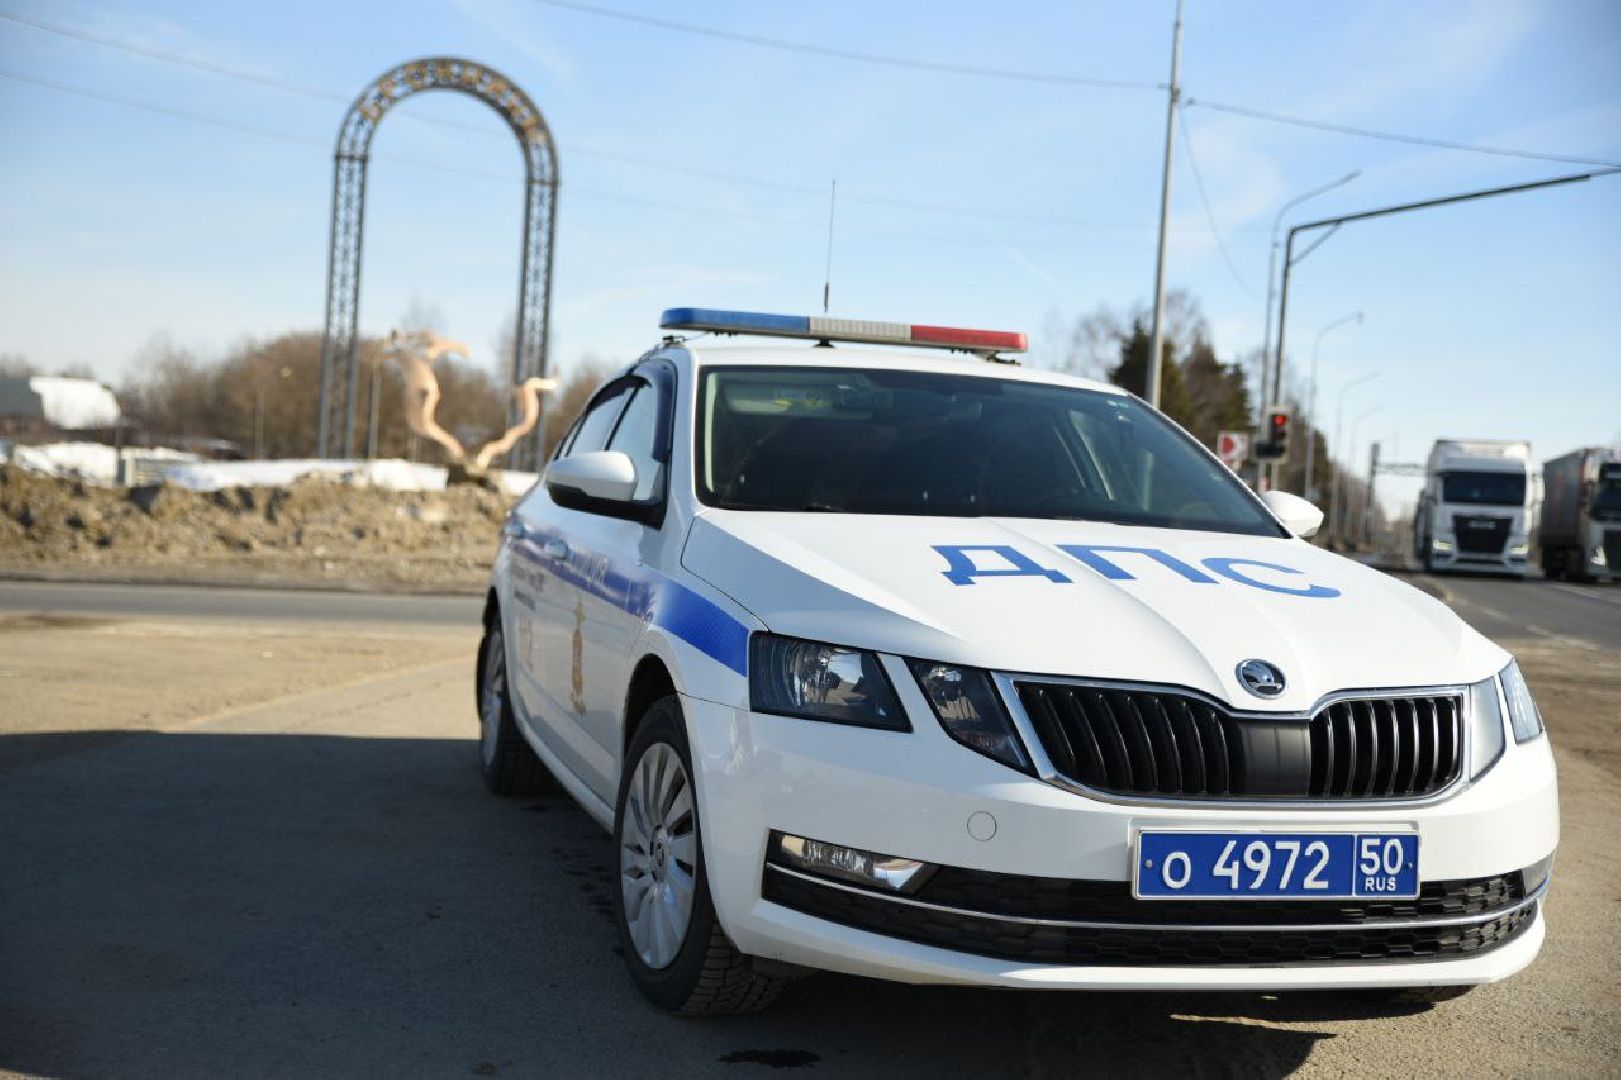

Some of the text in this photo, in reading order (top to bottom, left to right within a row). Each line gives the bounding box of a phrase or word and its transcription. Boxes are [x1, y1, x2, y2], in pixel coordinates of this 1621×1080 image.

[931, 544, 1341, 598] ДПС
[1212, 840, 1330, 889] 4972
[1359, 838, 1404, 875] 50
[1365, 876, 1396, 892] RUS
